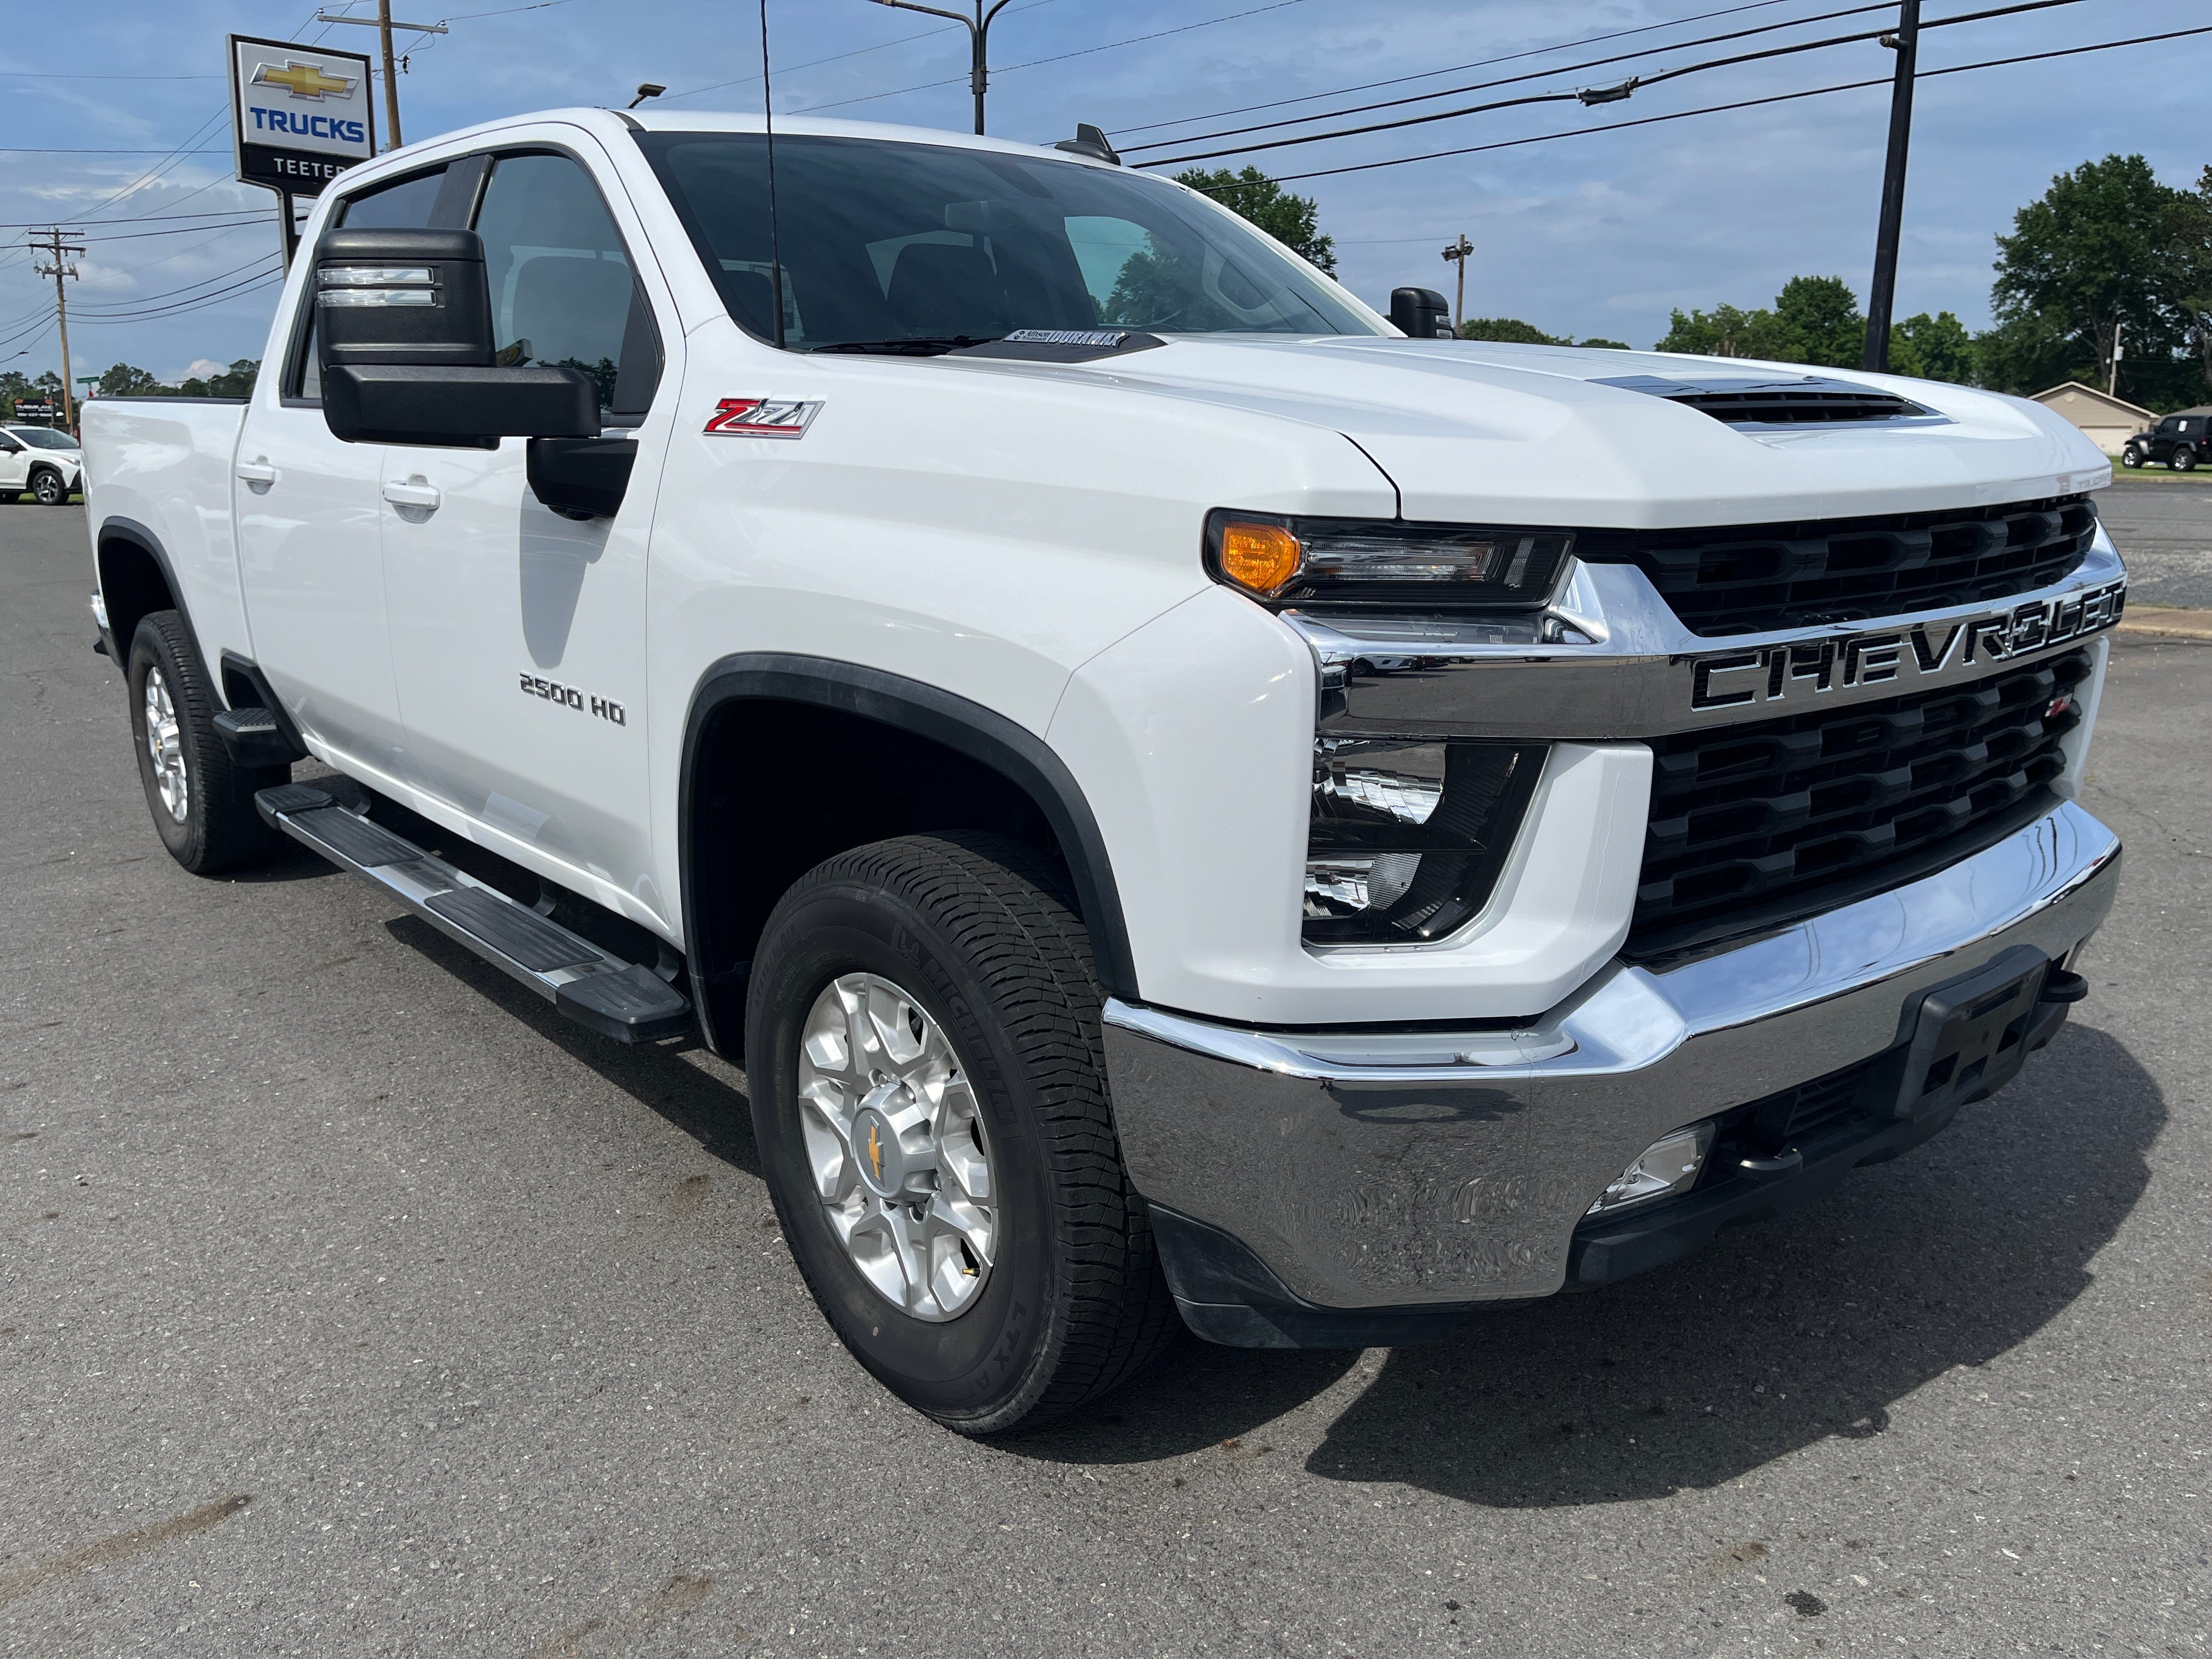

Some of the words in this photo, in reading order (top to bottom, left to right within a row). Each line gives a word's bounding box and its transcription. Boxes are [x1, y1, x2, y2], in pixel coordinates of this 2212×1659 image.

[250, 107, 364, 143] TRUCKS
[1048, 330, 1127, 348] DURAMAX
[701, 398, 826, 441] Z71
[1691, 580, 2123, 712] CHEVROLET
[520, 670, 584, 712] 2500
[590, 692, 627, 727] HD
[922, 958, 1019, 1125] MICHELIN
[993, 1300, 1026, 1370] LTX
